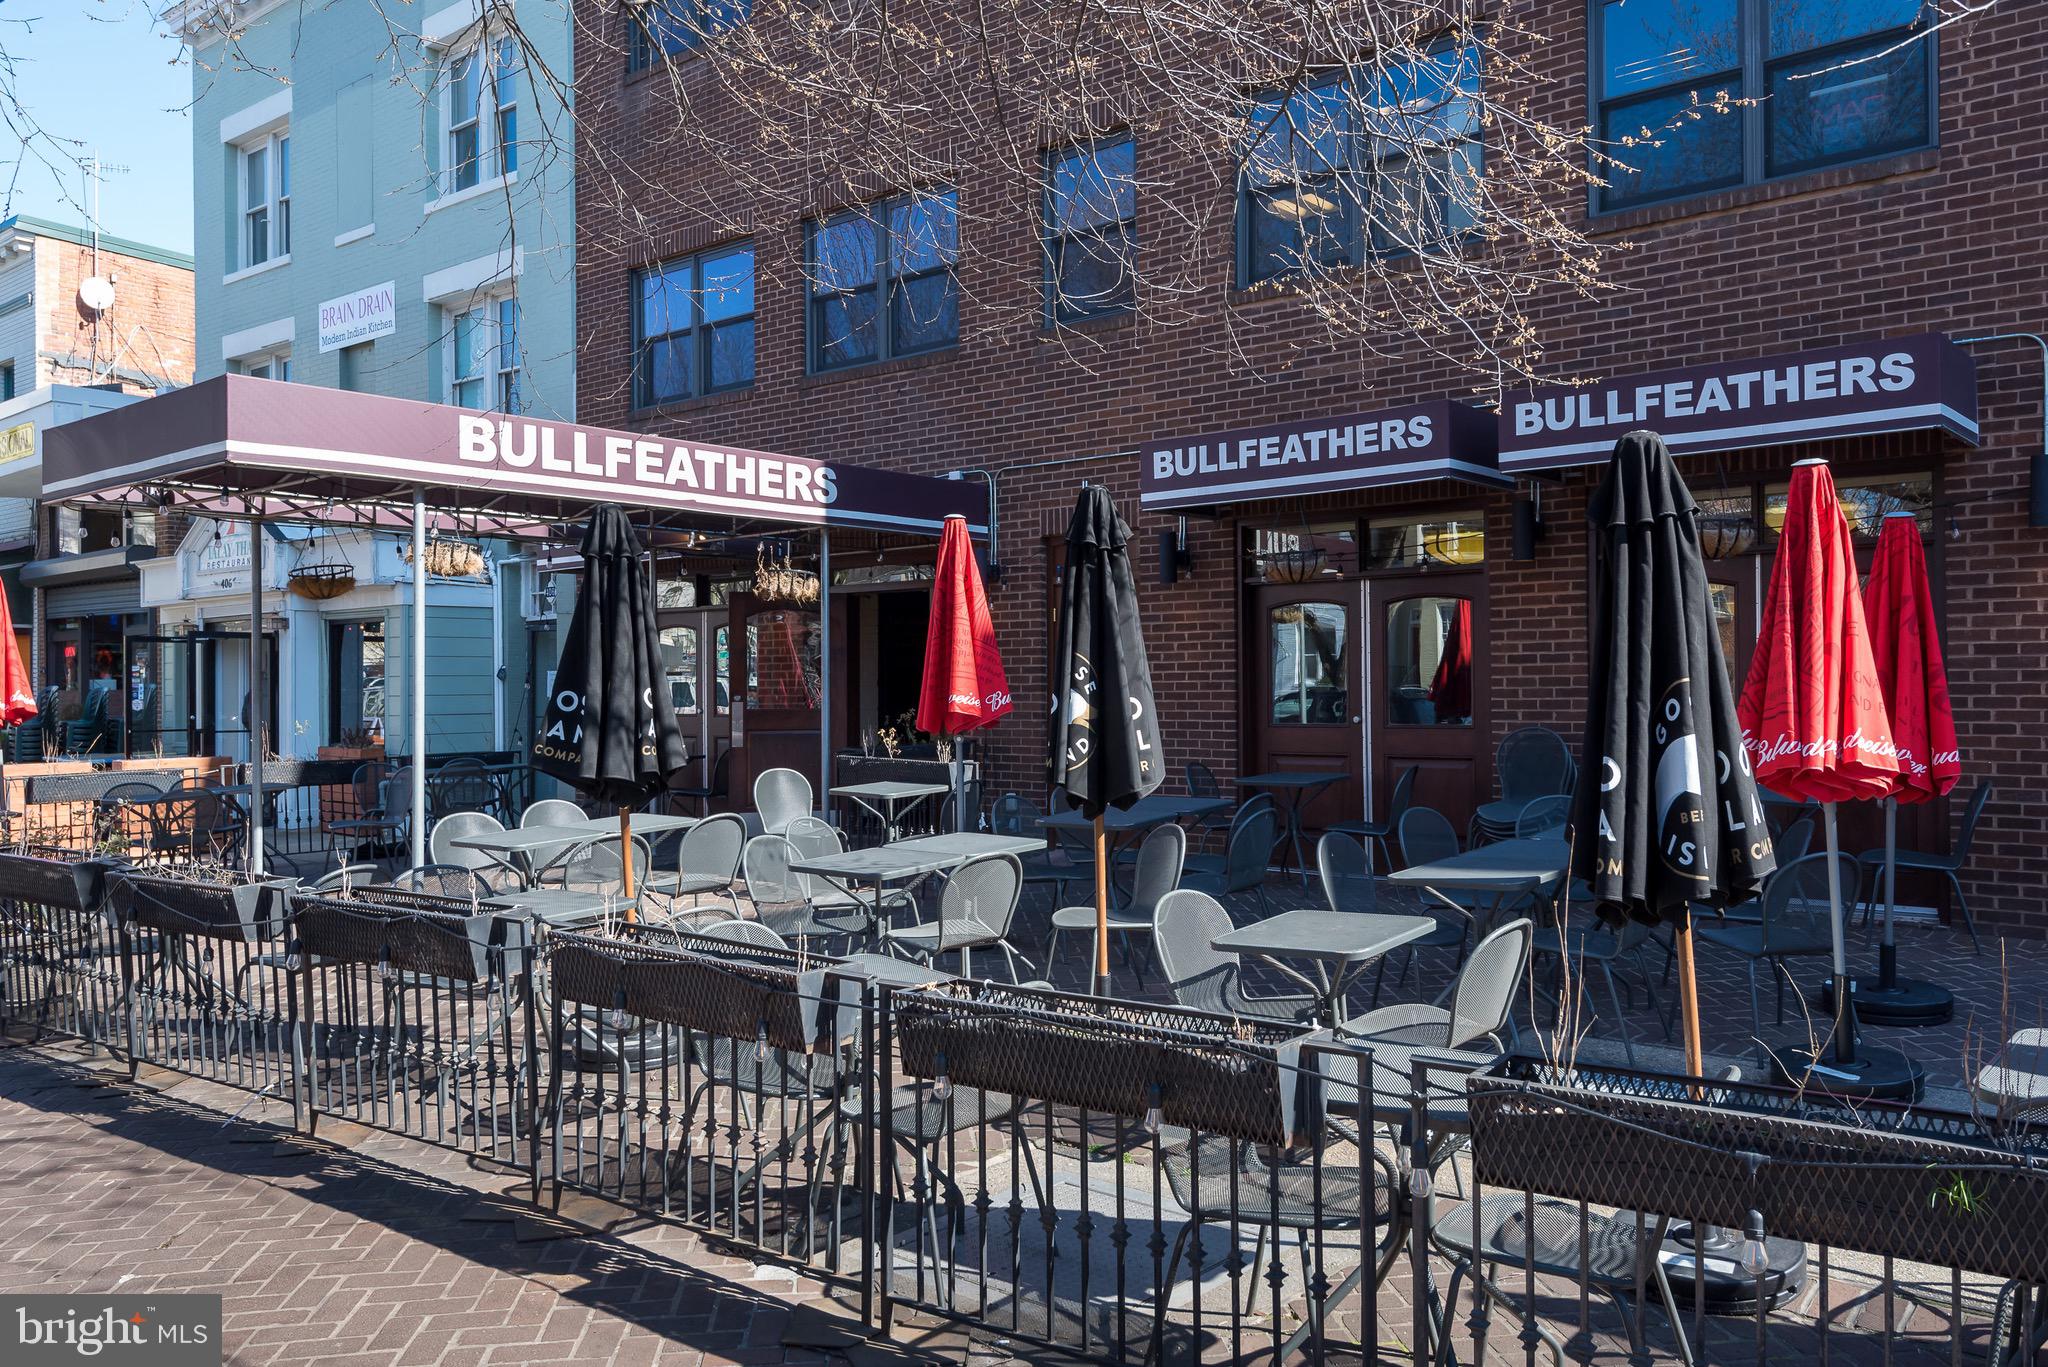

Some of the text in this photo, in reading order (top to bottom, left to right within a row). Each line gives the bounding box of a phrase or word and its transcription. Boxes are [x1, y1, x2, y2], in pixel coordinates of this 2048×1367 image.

[321, 288, 393, 330] BRAIN DRAIN
[321, 319, 393, 347] Modern Indian Kitchen
[1515, 351, 1916, 436] BULLFEATHERS
[458, 414, 838, 504] BULLFEATHERS
[1152, 415, 1433, 479] BULLFEATHERS
[207, 557, 252, 570] RESTAURAN
[220, 578, 233, 589] 406
